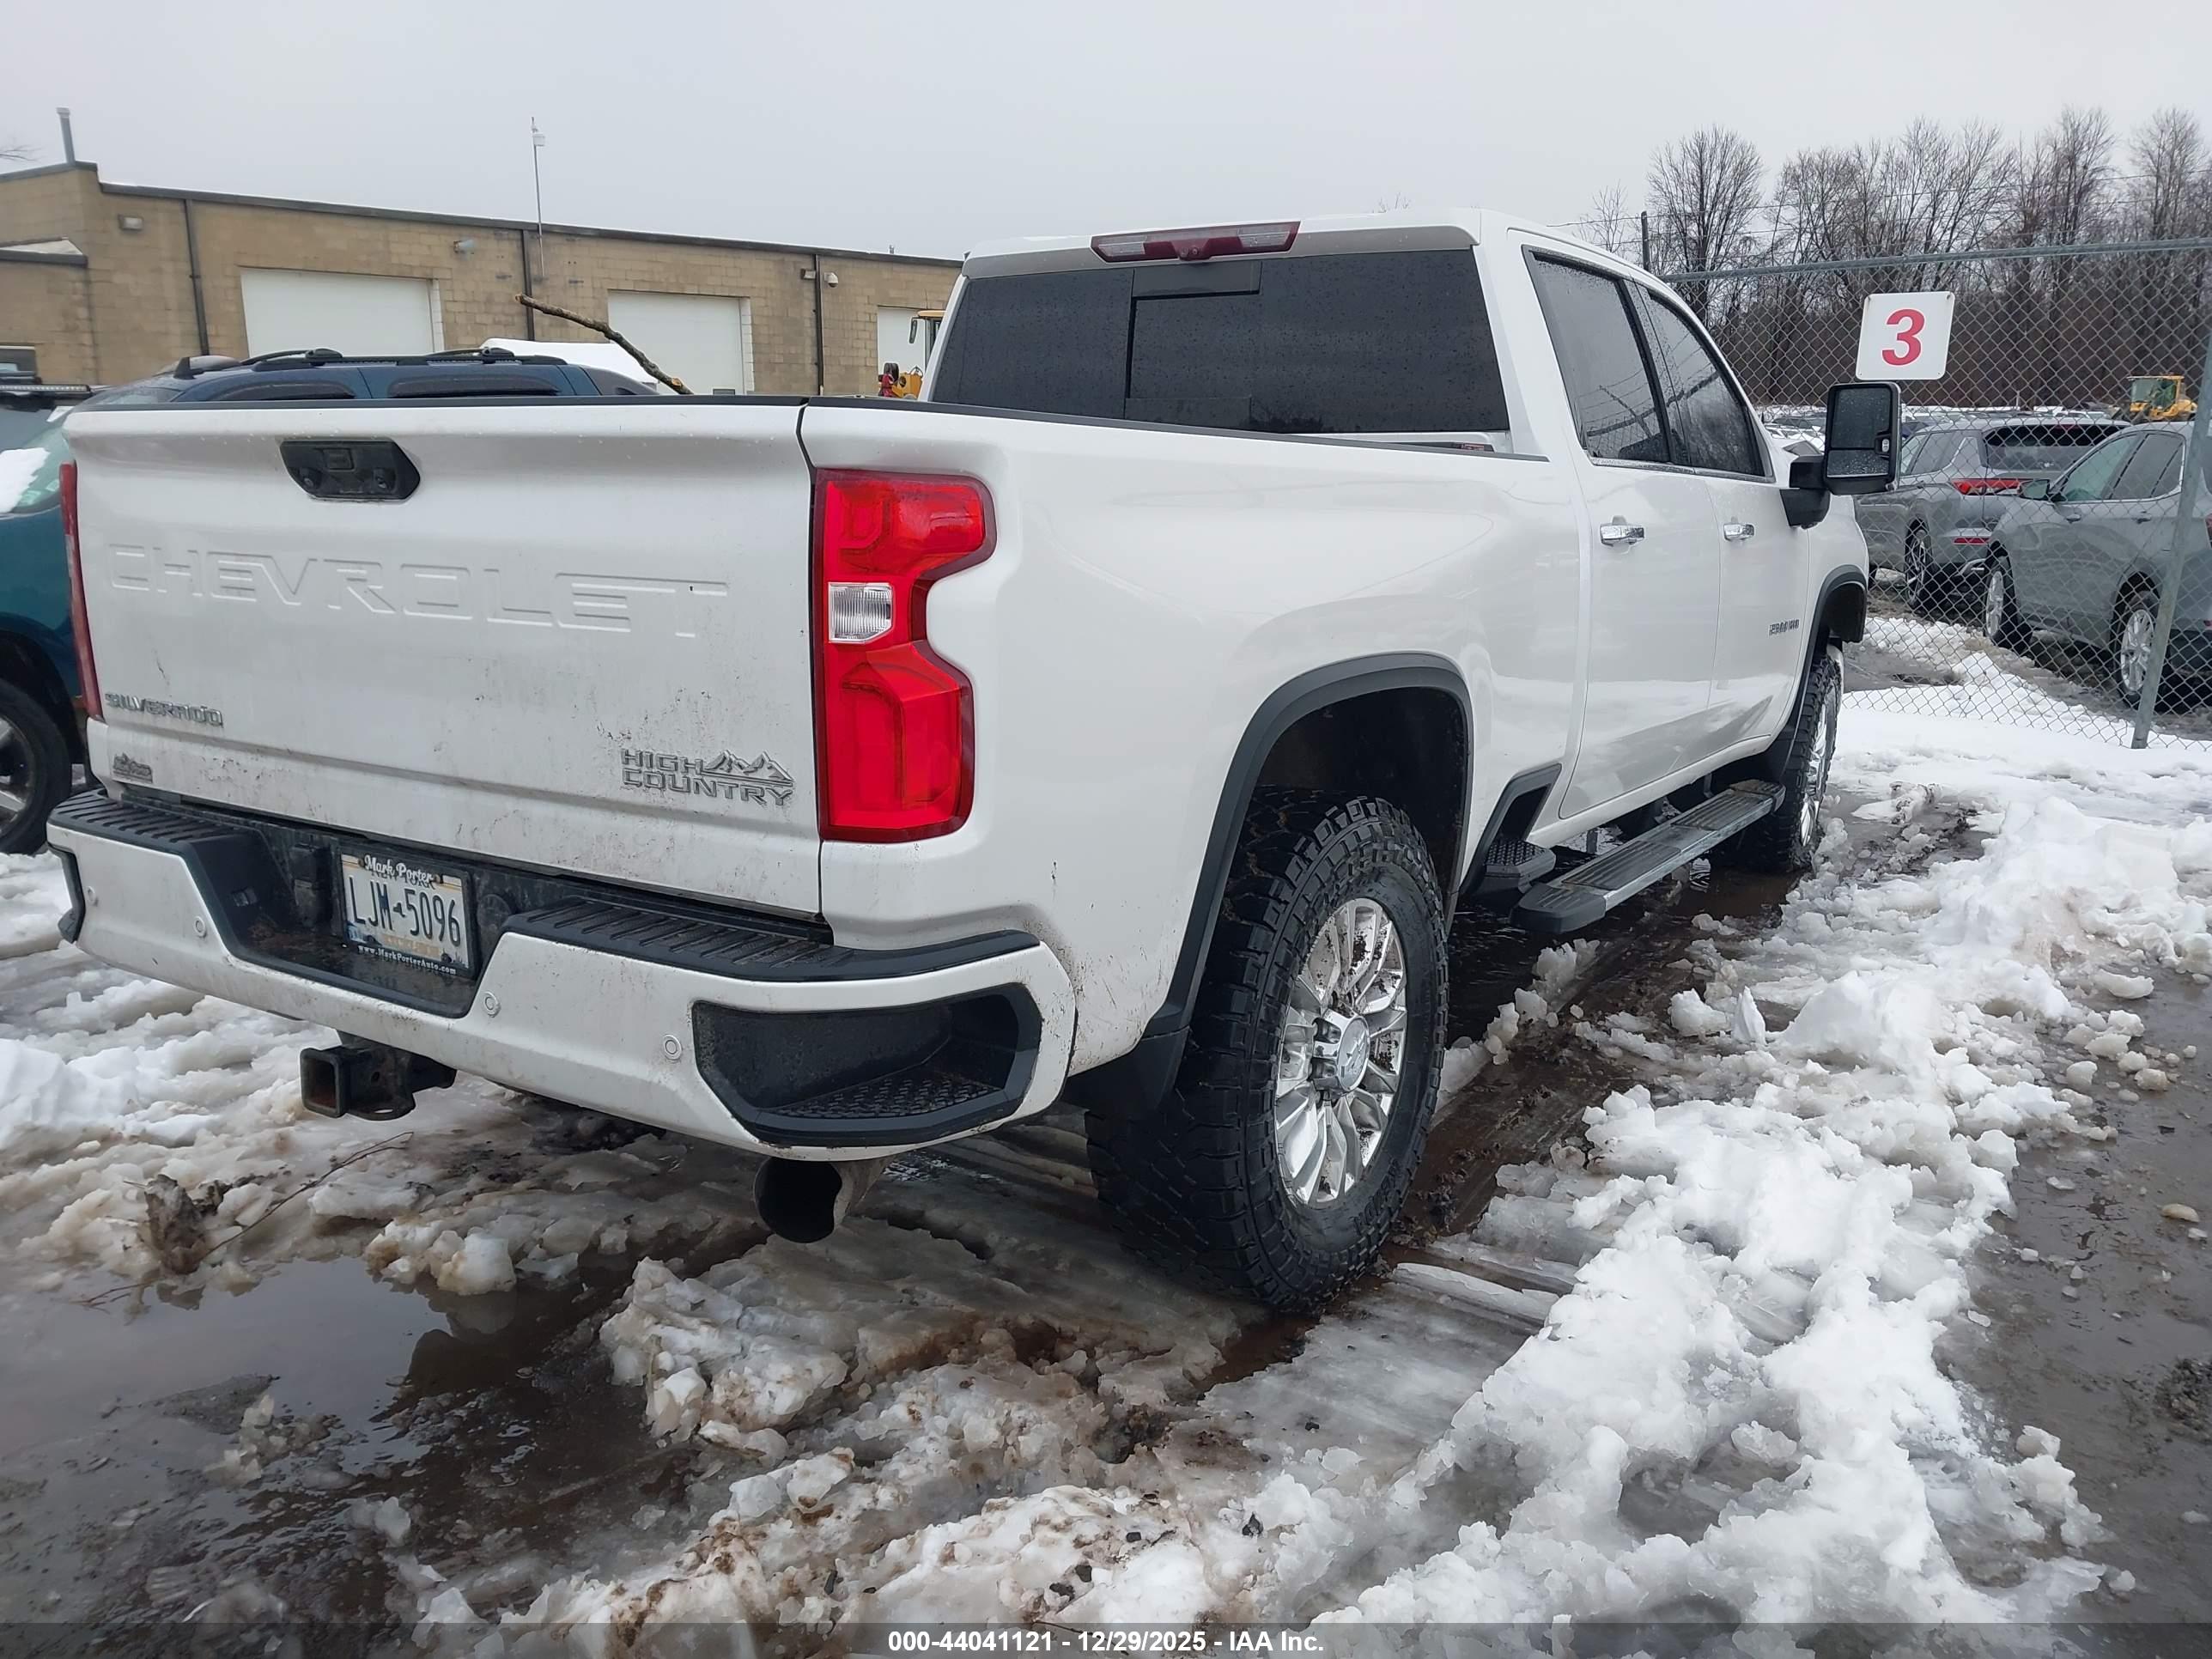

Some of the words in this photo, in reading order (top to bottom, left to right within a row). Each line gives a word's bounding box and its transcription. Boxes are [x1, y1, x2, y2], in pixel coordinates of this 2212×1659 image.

[1881, 308, 1925, 366] 3
[108, 544, 729, 638] CHEVROLET
[105, 693, 224, 727] SILVERADO
[621, 749, 703, 775] HIGH
[622, 768, 793, 805] COUNTRY
[364, 854, 396, 876] Mark
[396, 862, 434, 883] Porter
[357, 945, 457, 975] www.MarkPorterAuto.com
